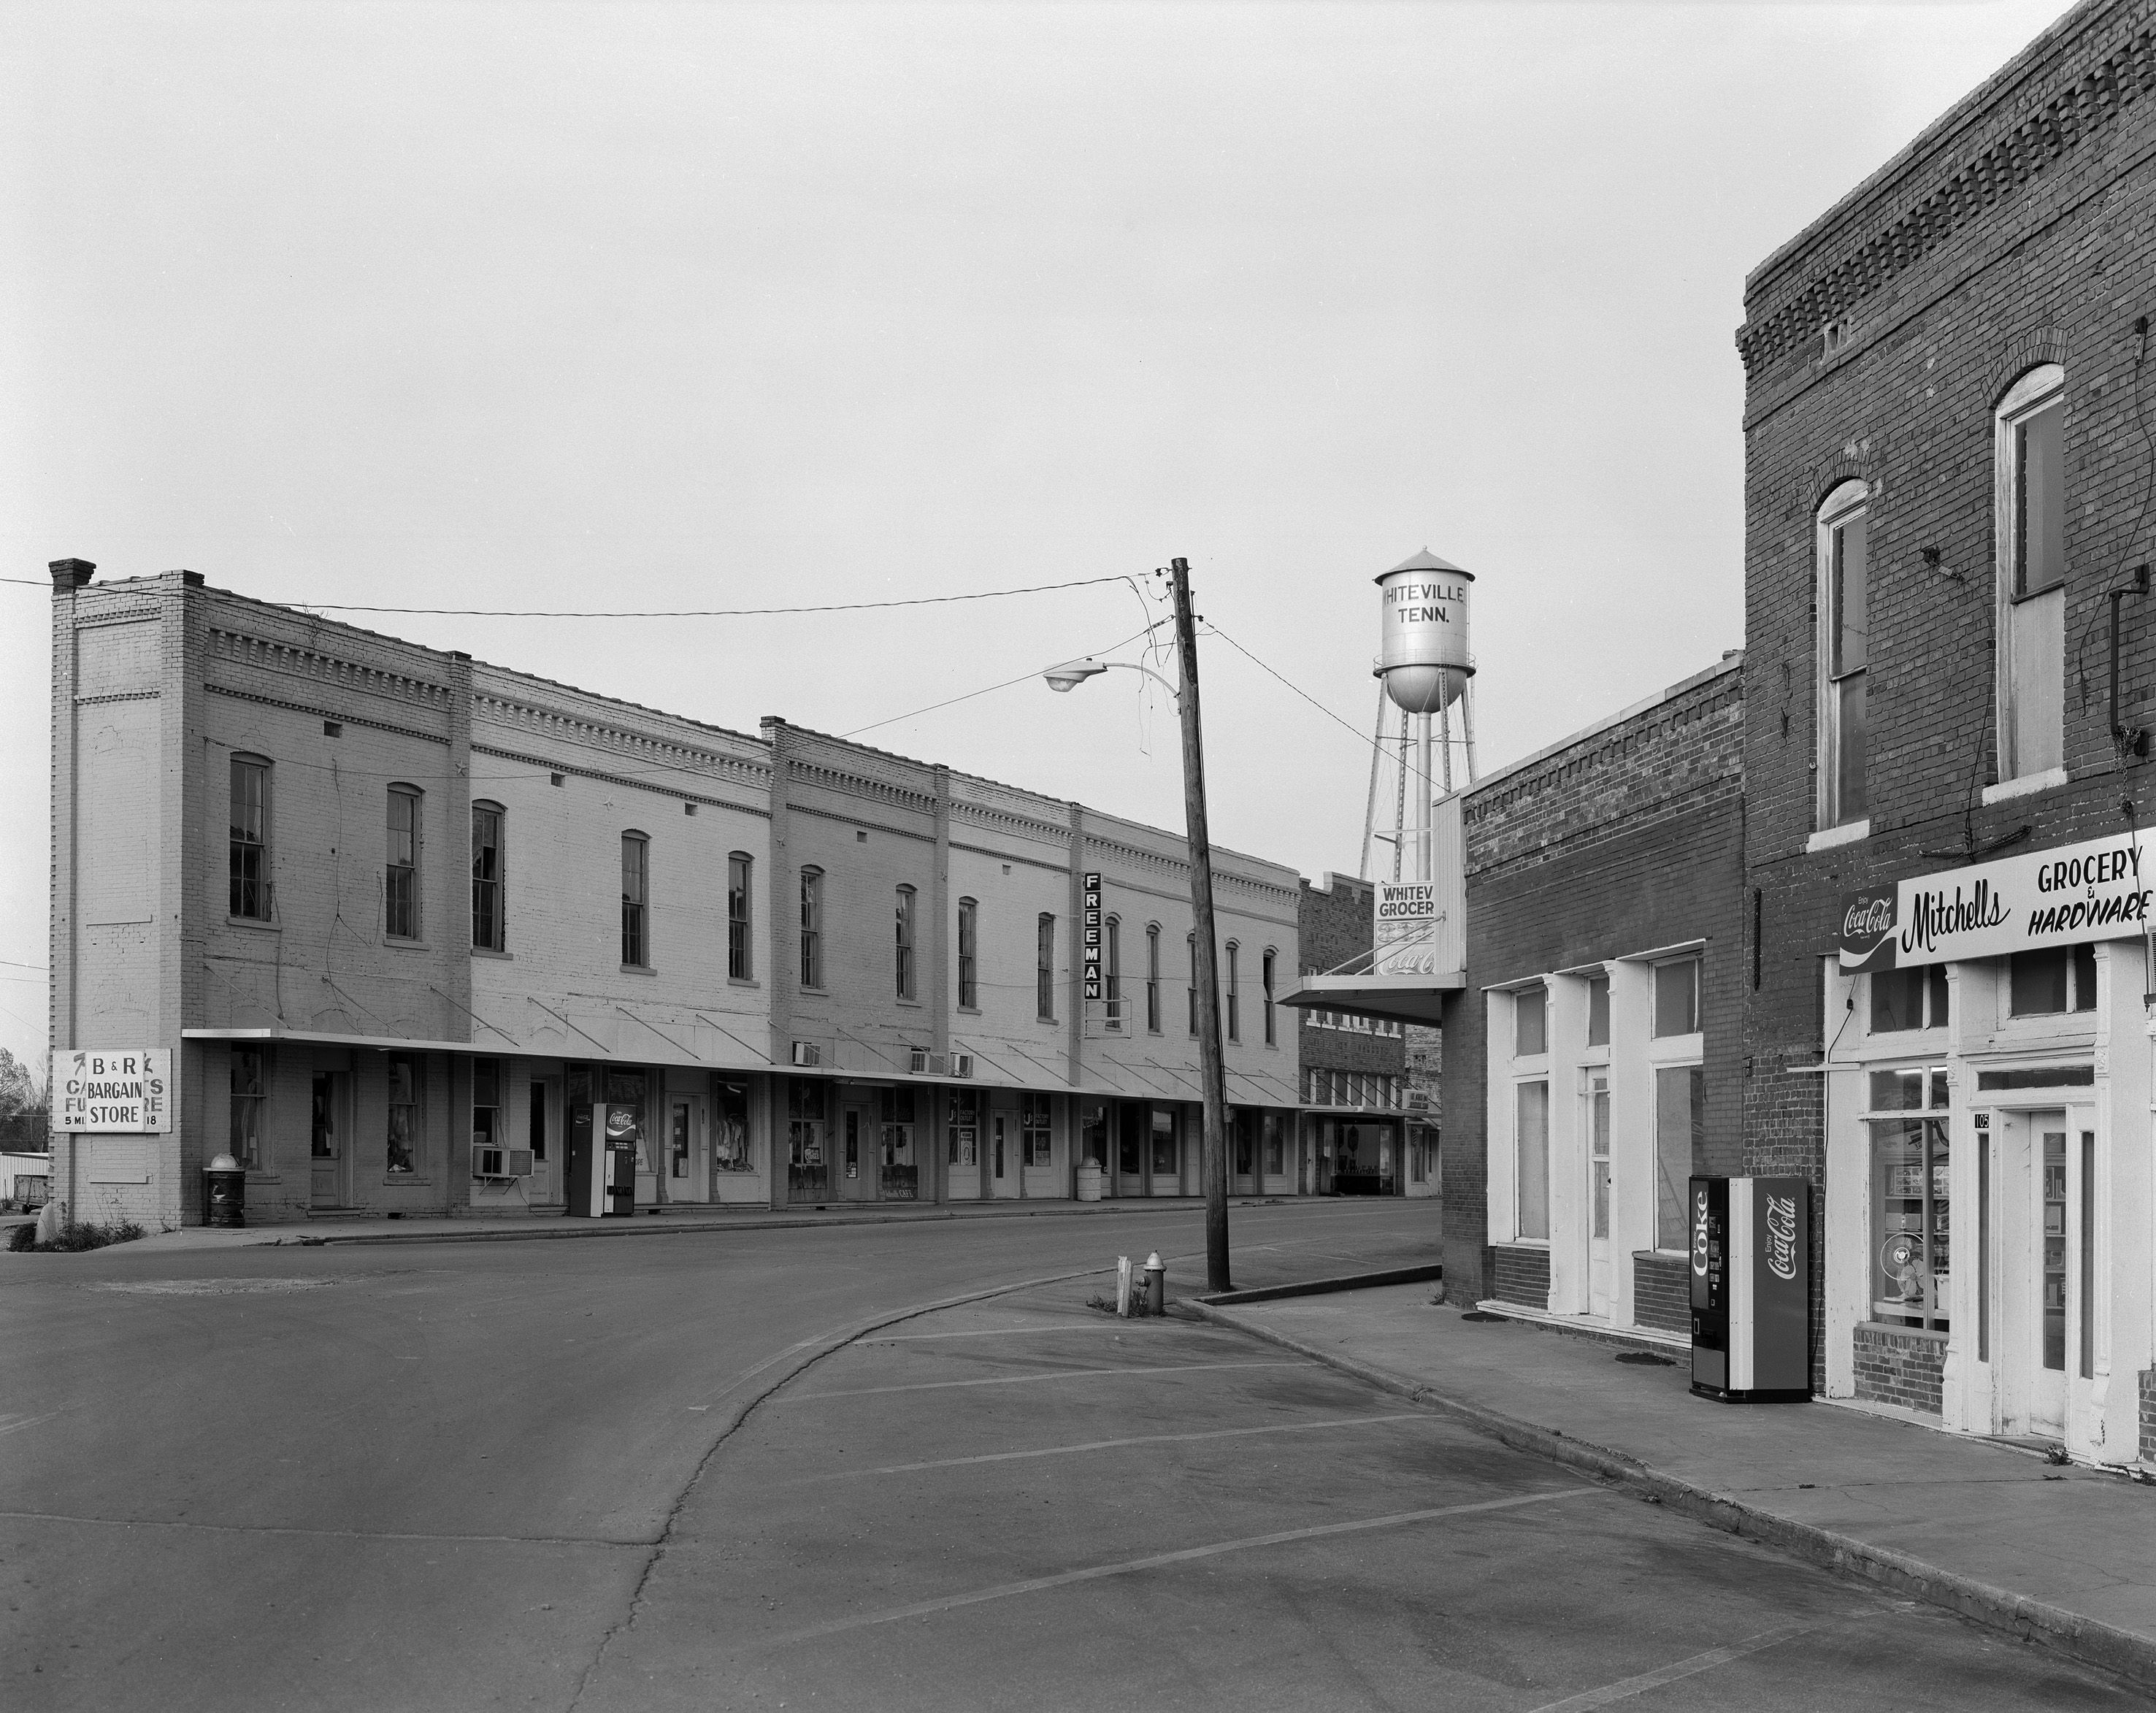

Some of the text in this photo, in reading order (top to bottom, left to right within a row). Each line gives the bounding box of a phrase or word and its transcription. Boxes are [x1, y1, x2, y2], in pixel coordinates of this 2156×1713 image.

[1384, 584, 1464, 605] HITEVILLE
[1398, 607, 1450, 624] TENN.
[2038, 846, 2143, 893] GROCERY
[2087, 886, 2095, 899] &
[1844, 895, 1893, 938] Coca-Cola
[1902, 878, 2011, 954] Mitchells
[2028, 889, 2153, 937] HARDWARE
[1085, 875, 1099, 997] FREEMAN
[93, 1058, 105, 1075] B
[111, 1061, 118, 1071] &
[123, 1057, 137, 1075] R
[88, 1081, 142, 1099] BARGAIN
[65, 1116, 72, 1125] 5
[147, 1116, 157, 1124] 18
[90, 1106, 139, 1124] STORE
[1976, 1114, 1989, 1128] 105
[899, 1189, 913, 1197] CAFE
[1692, 1191, 1708, 1276] Coke
[1767, 1193, 1796, 1279] Coca-Cola
